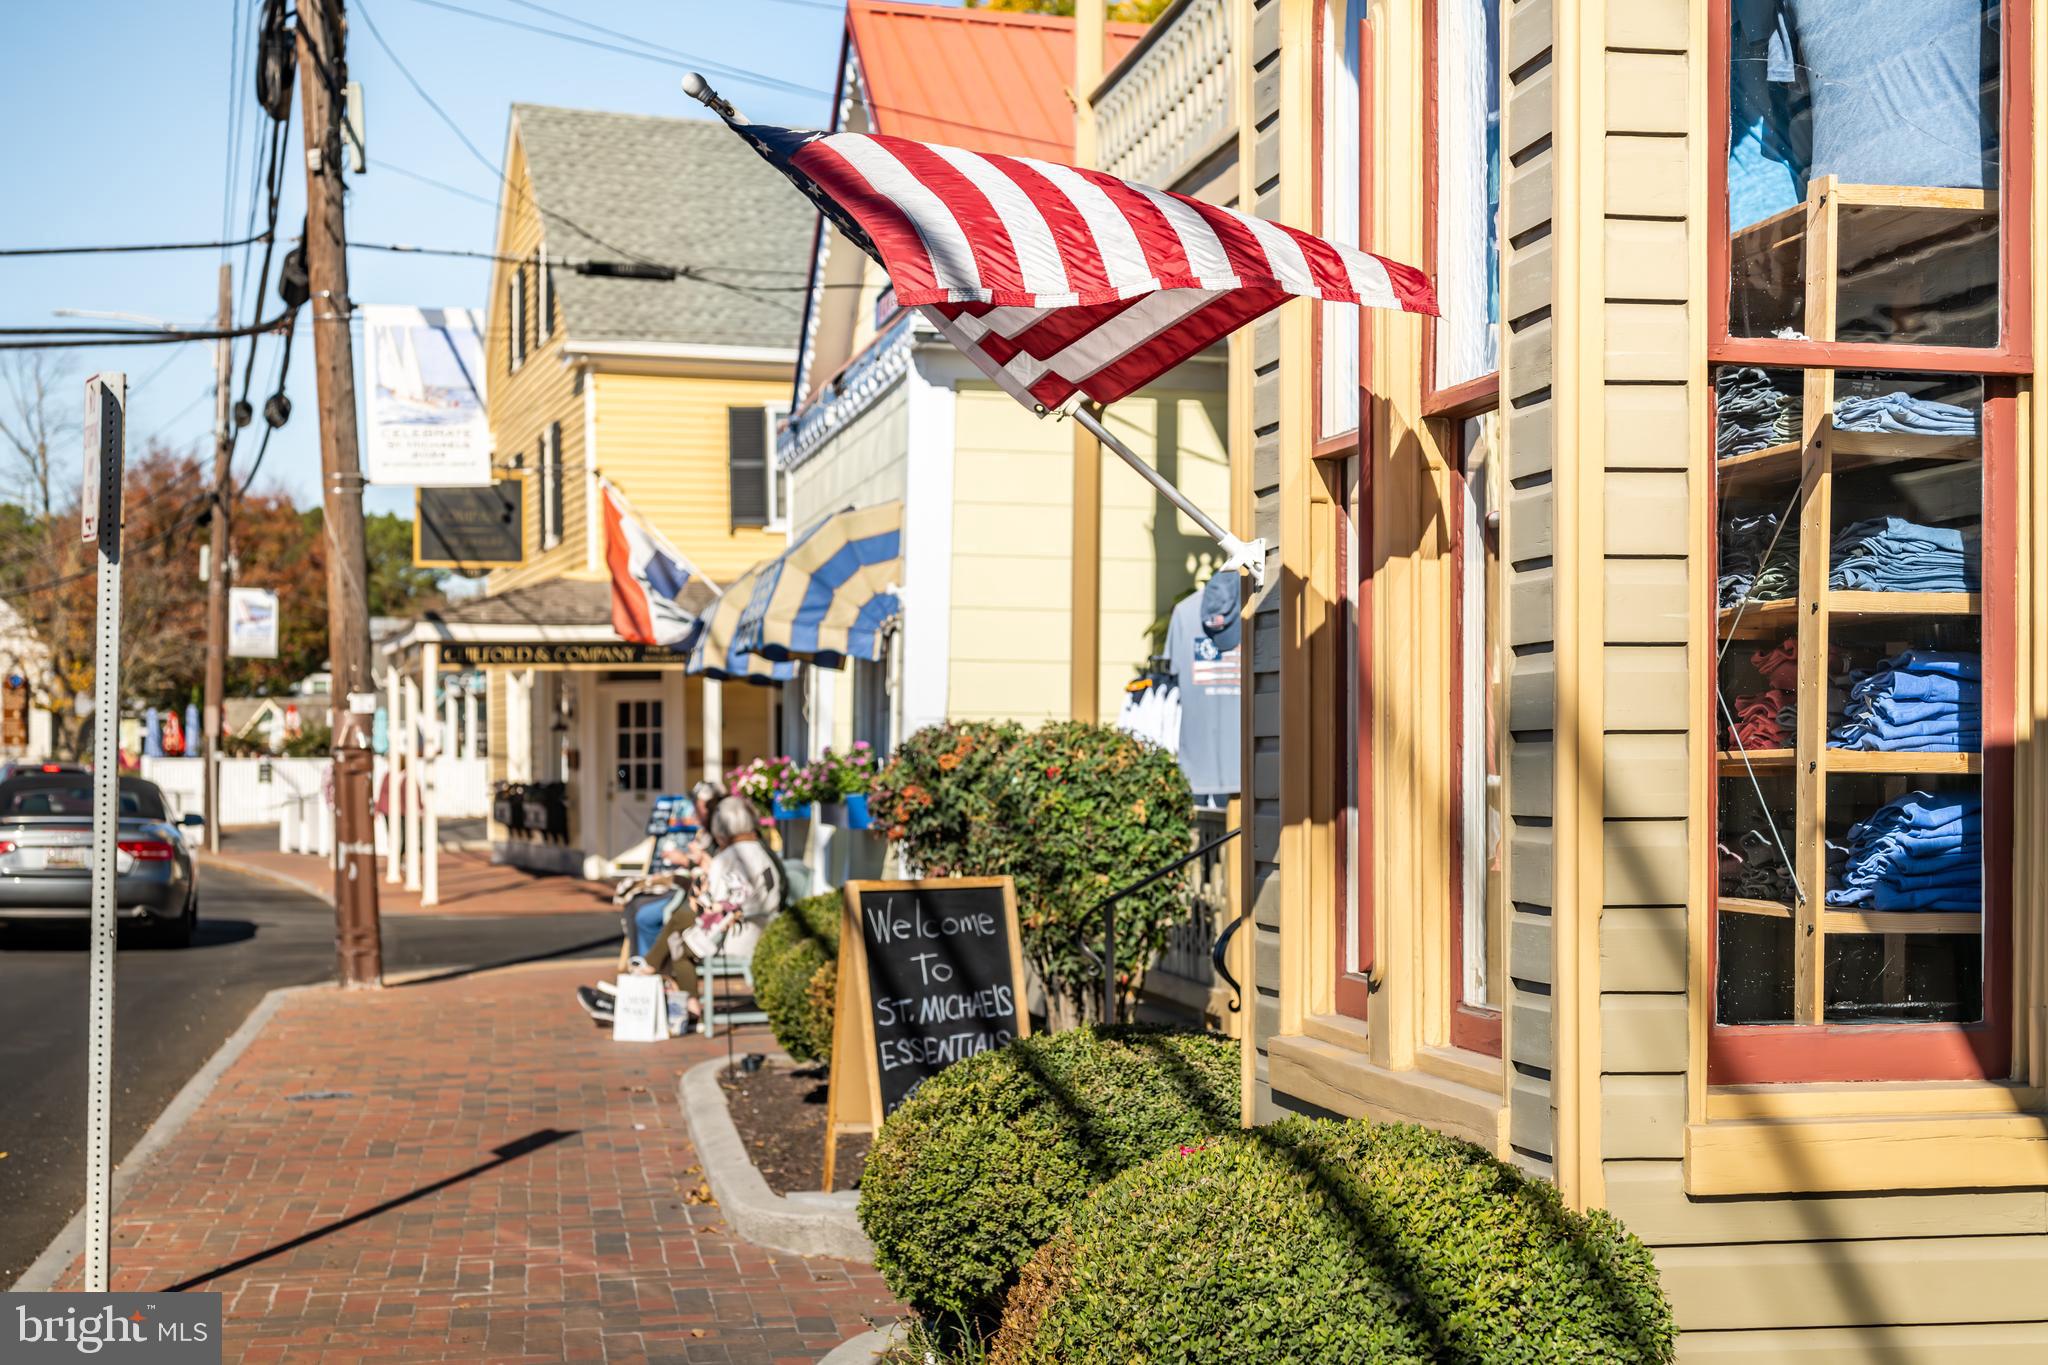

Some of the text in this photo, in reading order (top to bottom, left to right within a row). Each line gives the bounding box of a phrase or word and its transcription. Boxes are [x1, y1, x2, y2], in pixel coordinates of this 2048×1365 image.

[534, 646, 549, 663] &
[554, 646, 634, 663] COMPANY
[867, 897, 996, 944] Welcome
[910, 953, 953, 985] To
[877, 984, 1014, 1026] ST. MICHAELS
